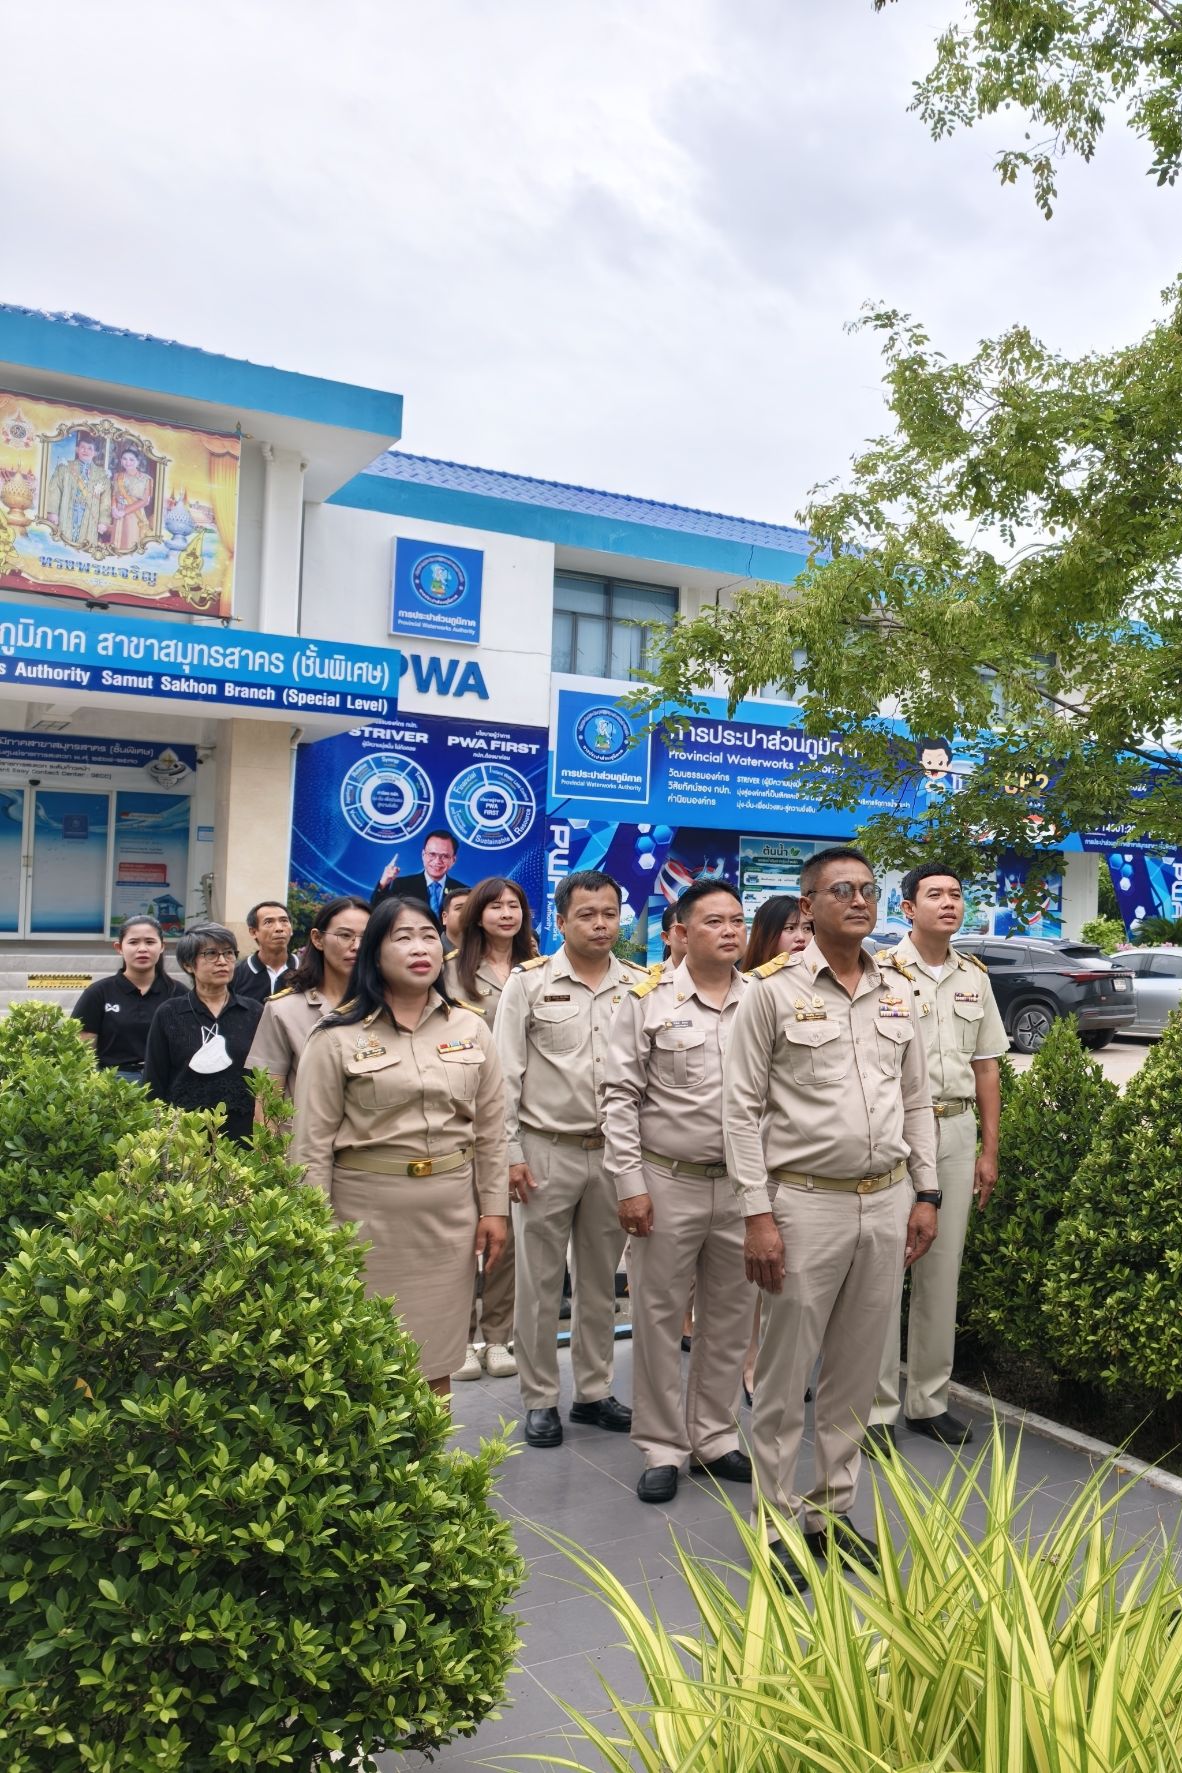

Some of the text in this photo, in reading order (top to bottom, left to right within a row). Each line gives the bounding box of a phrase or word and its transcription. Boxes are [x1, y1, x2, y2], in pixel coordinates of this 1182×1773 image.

[97, 632, 284, 674] สาขาสมุทรสาคร
[292, 644, 390, 691] (ชั้นพิเศษ)
[14, 661, 91, 686] Authority
[101, 669, 154, 689] Samut
[160, 675, 217, 695] Sakhon
[224, 682, 276, 701] Branch
[283, 688, 340, 708] (Special
[346, 698, 388, 715] Level)
[348, 726, 429, 744] STRIVER
[447, 735, 540, 755] PWA FIRST
[669, 750, 723, 764] Provincial
[727, 753, 794, 770] Waterworks
[561, 769, 642, 783] การประปาส่วนภูมิภาค
[561, 779, 641, 792] Provincial Waterworks Authority
[763, 843, 788, 857] ต้นน้ำ
